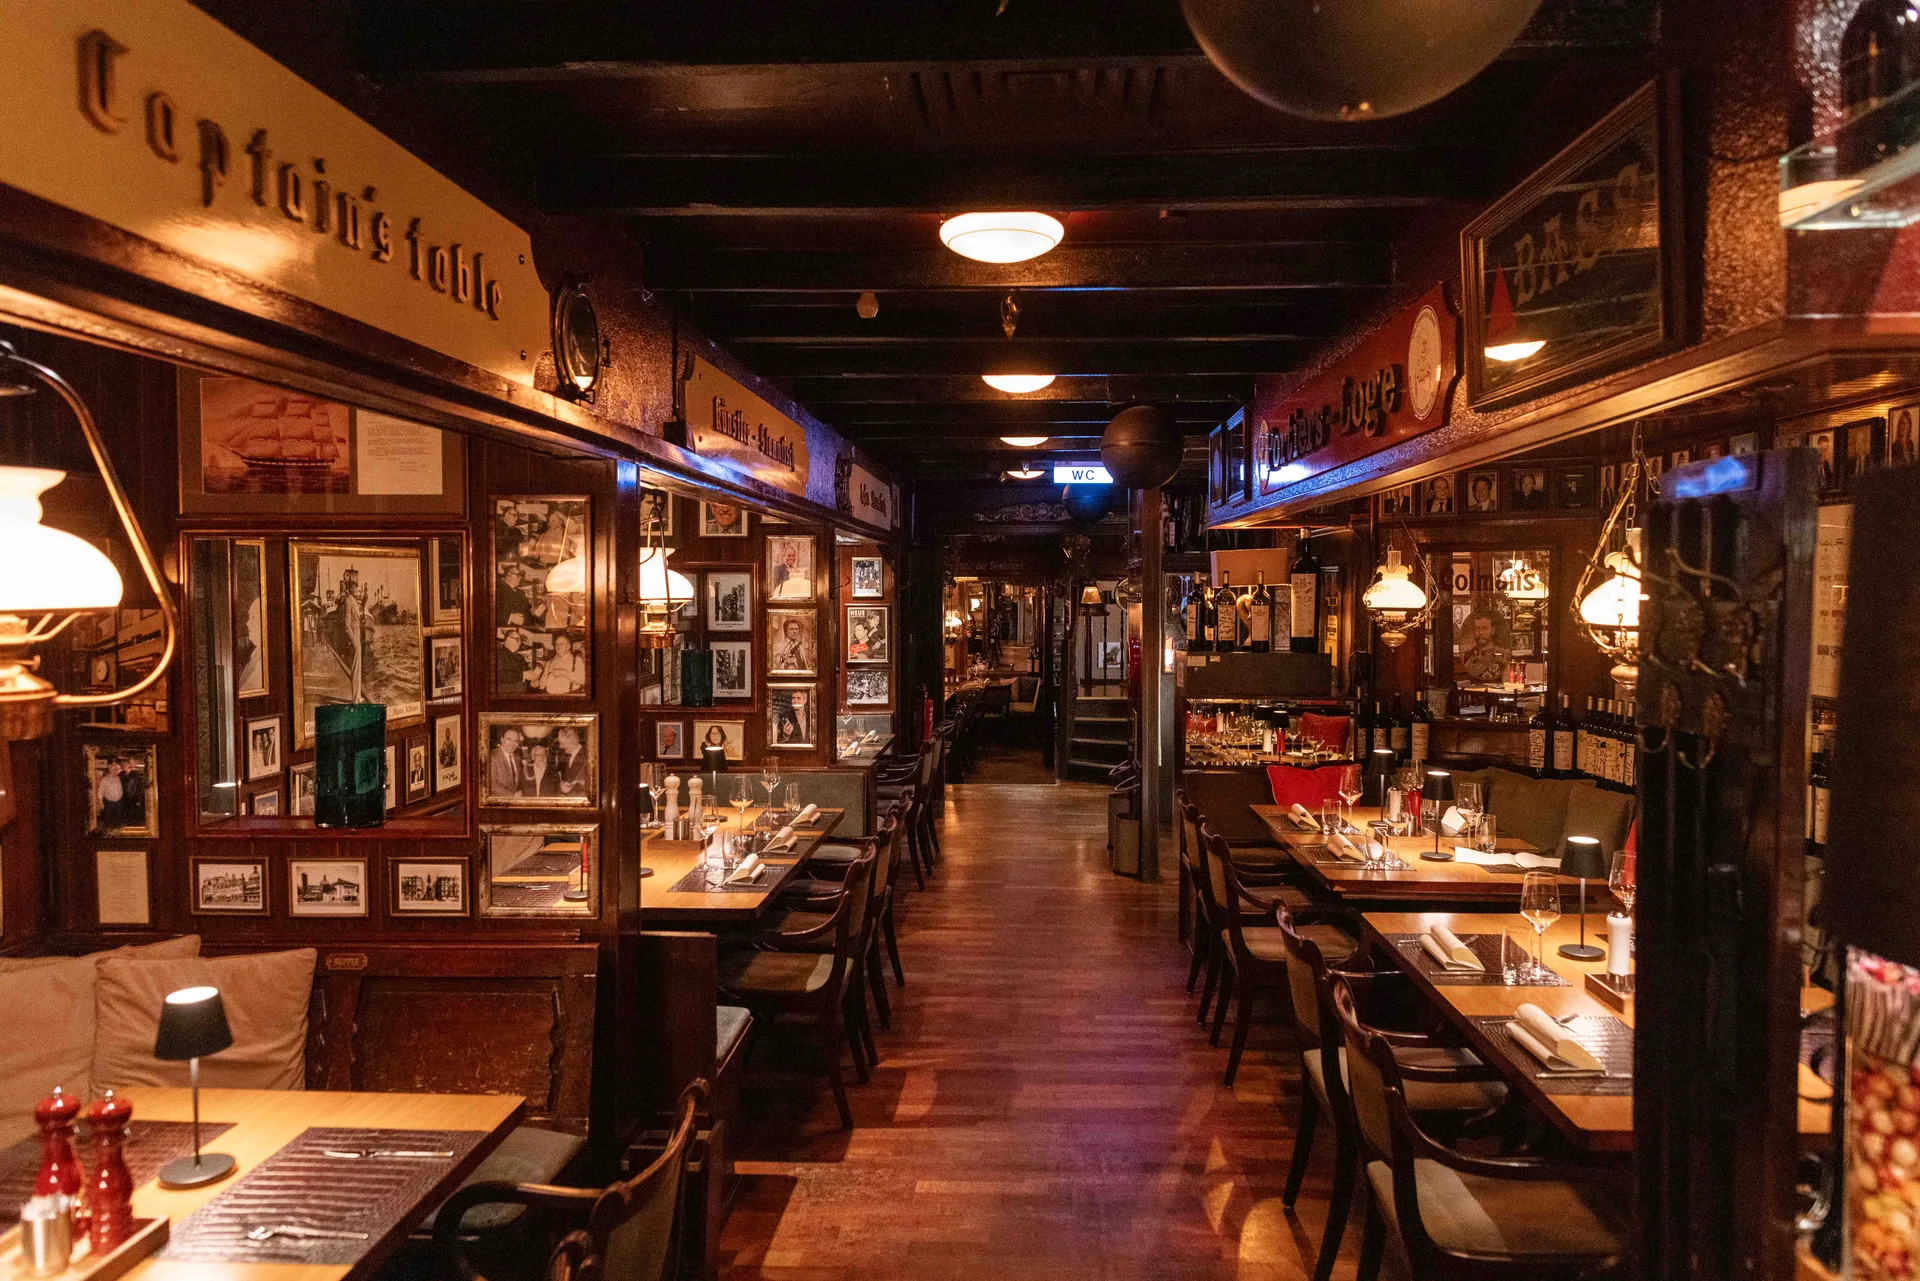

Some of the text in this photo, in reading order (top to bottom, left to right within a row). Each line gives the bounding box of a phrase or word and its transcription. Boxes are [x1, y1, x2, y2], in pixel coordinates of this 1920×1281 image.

[76, 27, 503, 321] Captain's table
[1071, 469, 1095, 481] WC
